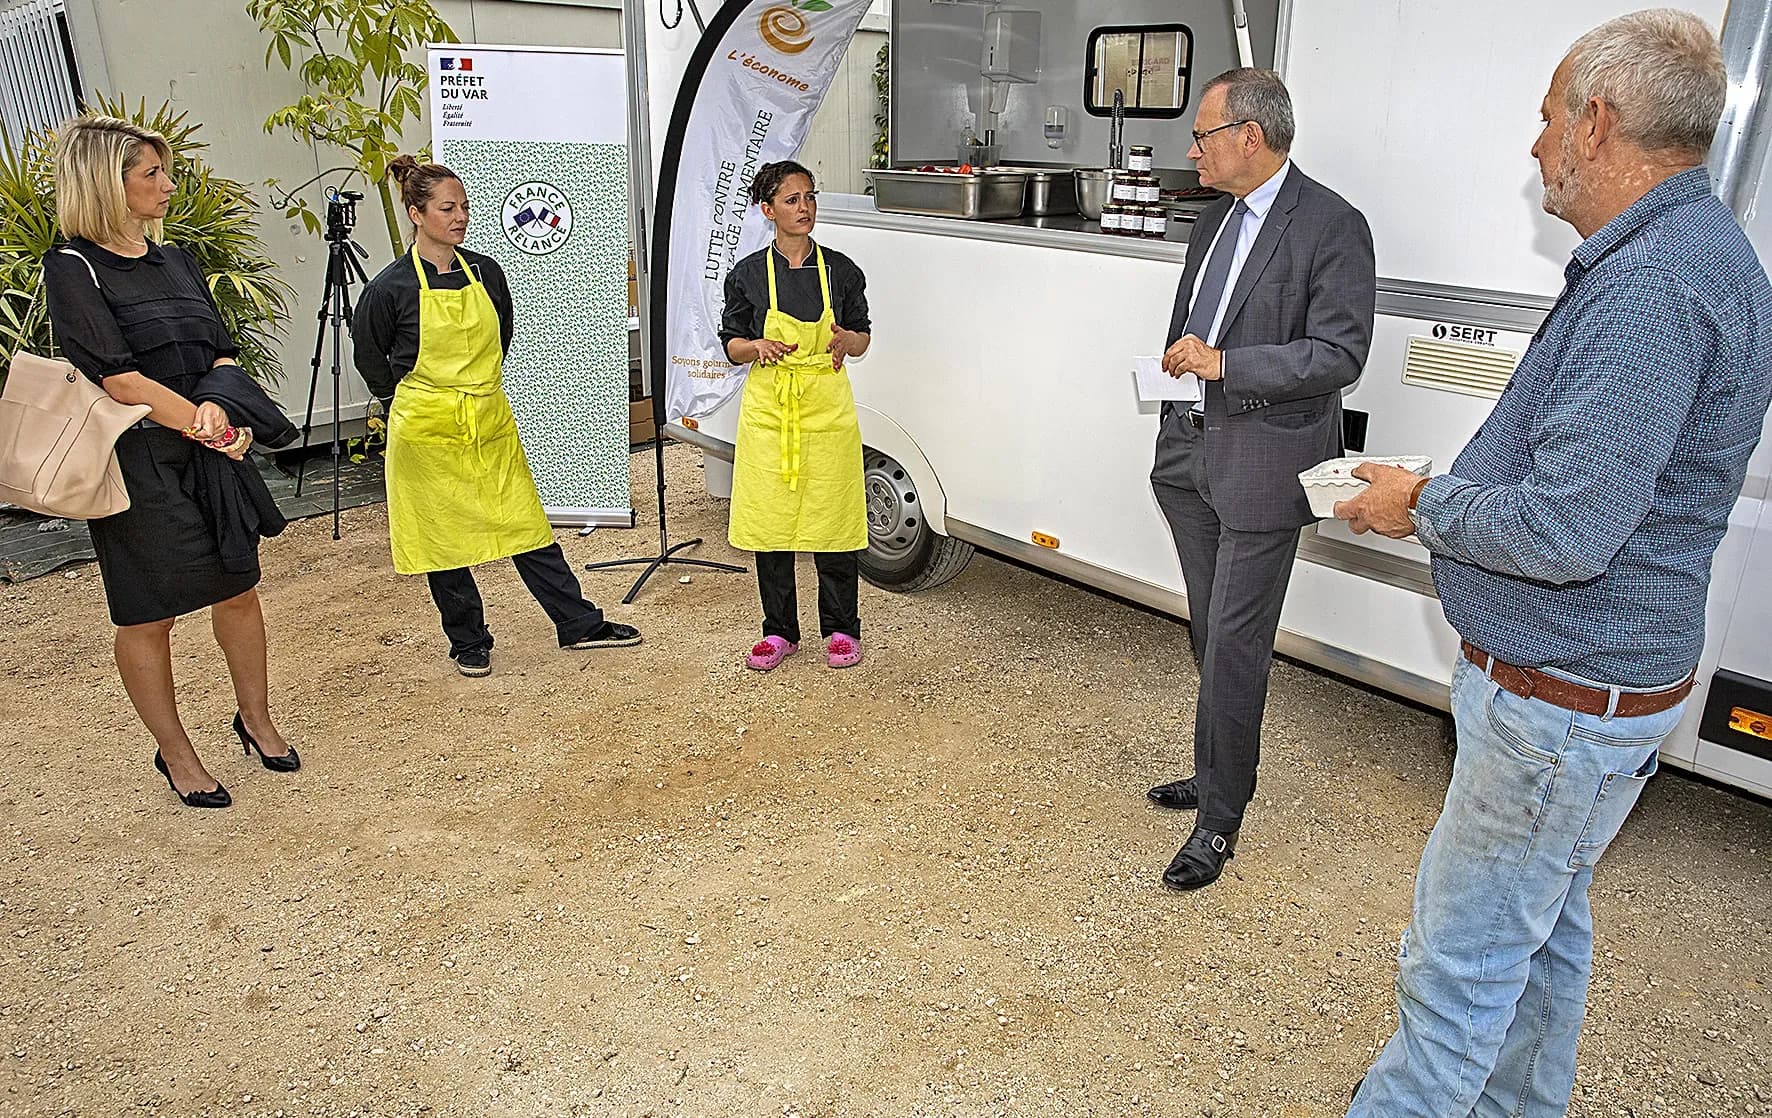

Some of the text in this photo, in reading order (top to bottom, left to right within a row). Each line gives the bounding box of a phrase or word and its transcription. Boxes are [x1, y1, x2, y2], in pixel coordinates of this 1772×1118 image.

[727, 49, 809, 92] L'économe
[440, 73, 485, 87] PRÉFET
[441, 88, 489, 100] DU VAR
[442, 103, 463, 111] Liberté
[442, 111, 464, 120] Égalité
[731, 109, 773, 220] ALIMENTAIRE
[509, 186, 566, 211] FRANCE
[713, 160, 736, 226] CONTRE
[508, 225, 567, 251] RELANCE
[704, 229, 724, 281] LUTTE
[1450, 326, 1498, 343] SERT
[671, 355, 701, 367] Soyons
[687, 369, 726, 379] solidaires
